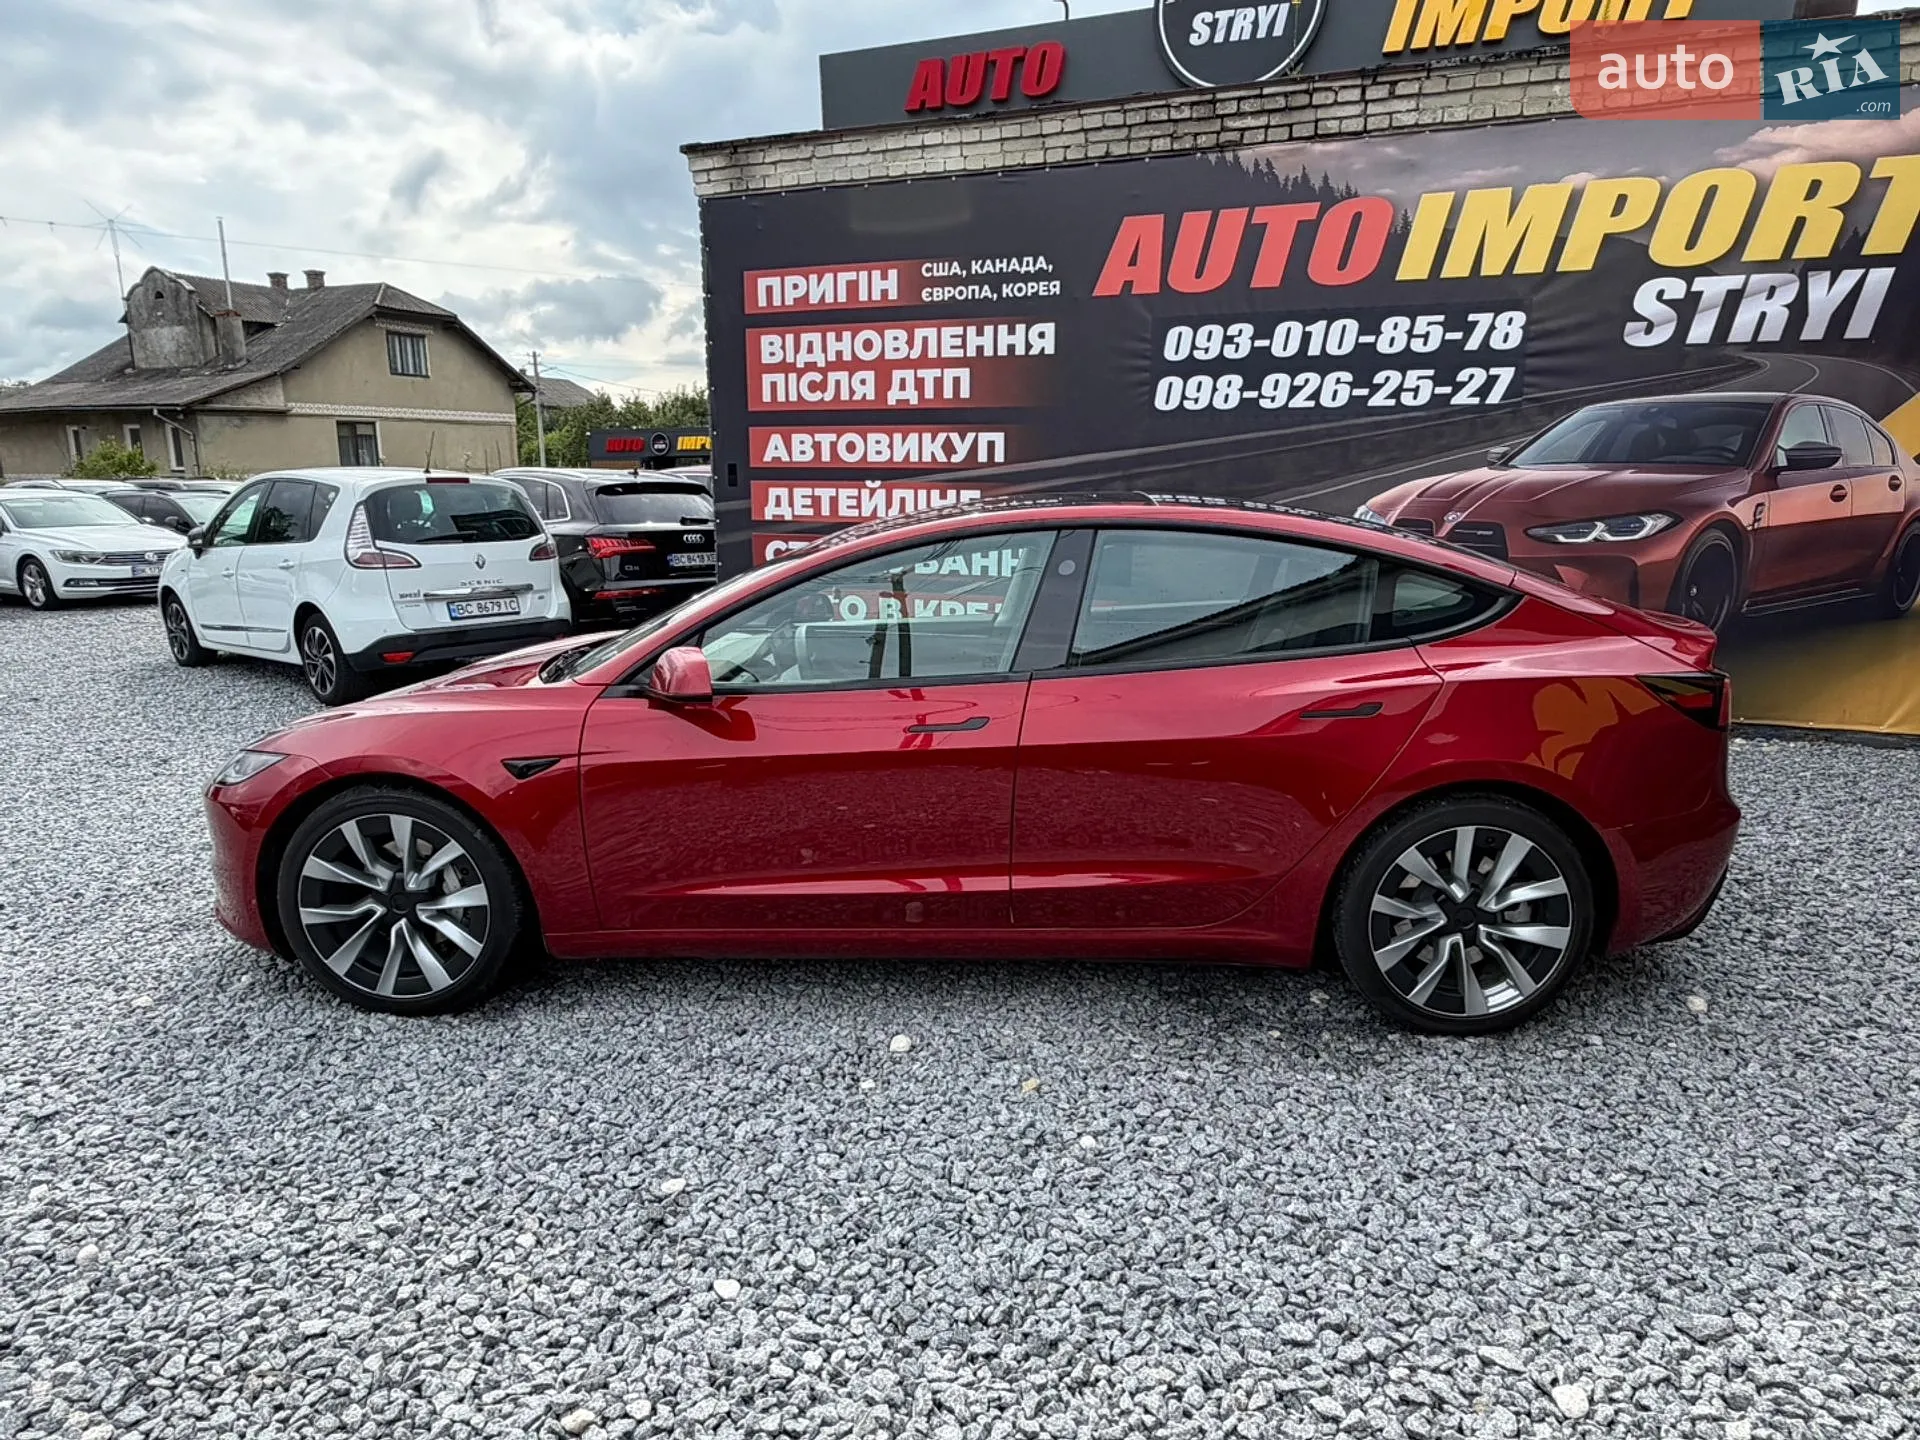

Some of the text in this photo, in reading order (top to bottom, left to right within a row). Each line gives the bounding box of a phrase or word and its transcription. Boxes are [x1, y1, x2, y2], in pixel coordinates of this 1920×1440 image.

[1188, 2, 1291, 46] STRYI
[904, 40, 1067, 112] AUTO
[921, 255, 1053, 278] США, КАНАДА,
[757, 268, 898, 307] ПРИГІН
[921, 280, 1061, 302] ЄВРОПА, КОРЕЯ
[1623, 266, 1896, 347] STRYI
[760, 322, 1056, 367] ВІДНОВЛЕННЯ
[1163, 311, 1527, 361] 093-010-85-78
[761, 368, 971, 405] ПІСЛЯ ДТП
[1154, 366, 1516, 411] 098-926-25-27
[763, 431, 1005, 464] АВТОВИКУП
[456, 602, 474, 616] BC
[476, 600, 501, 613] 8679
